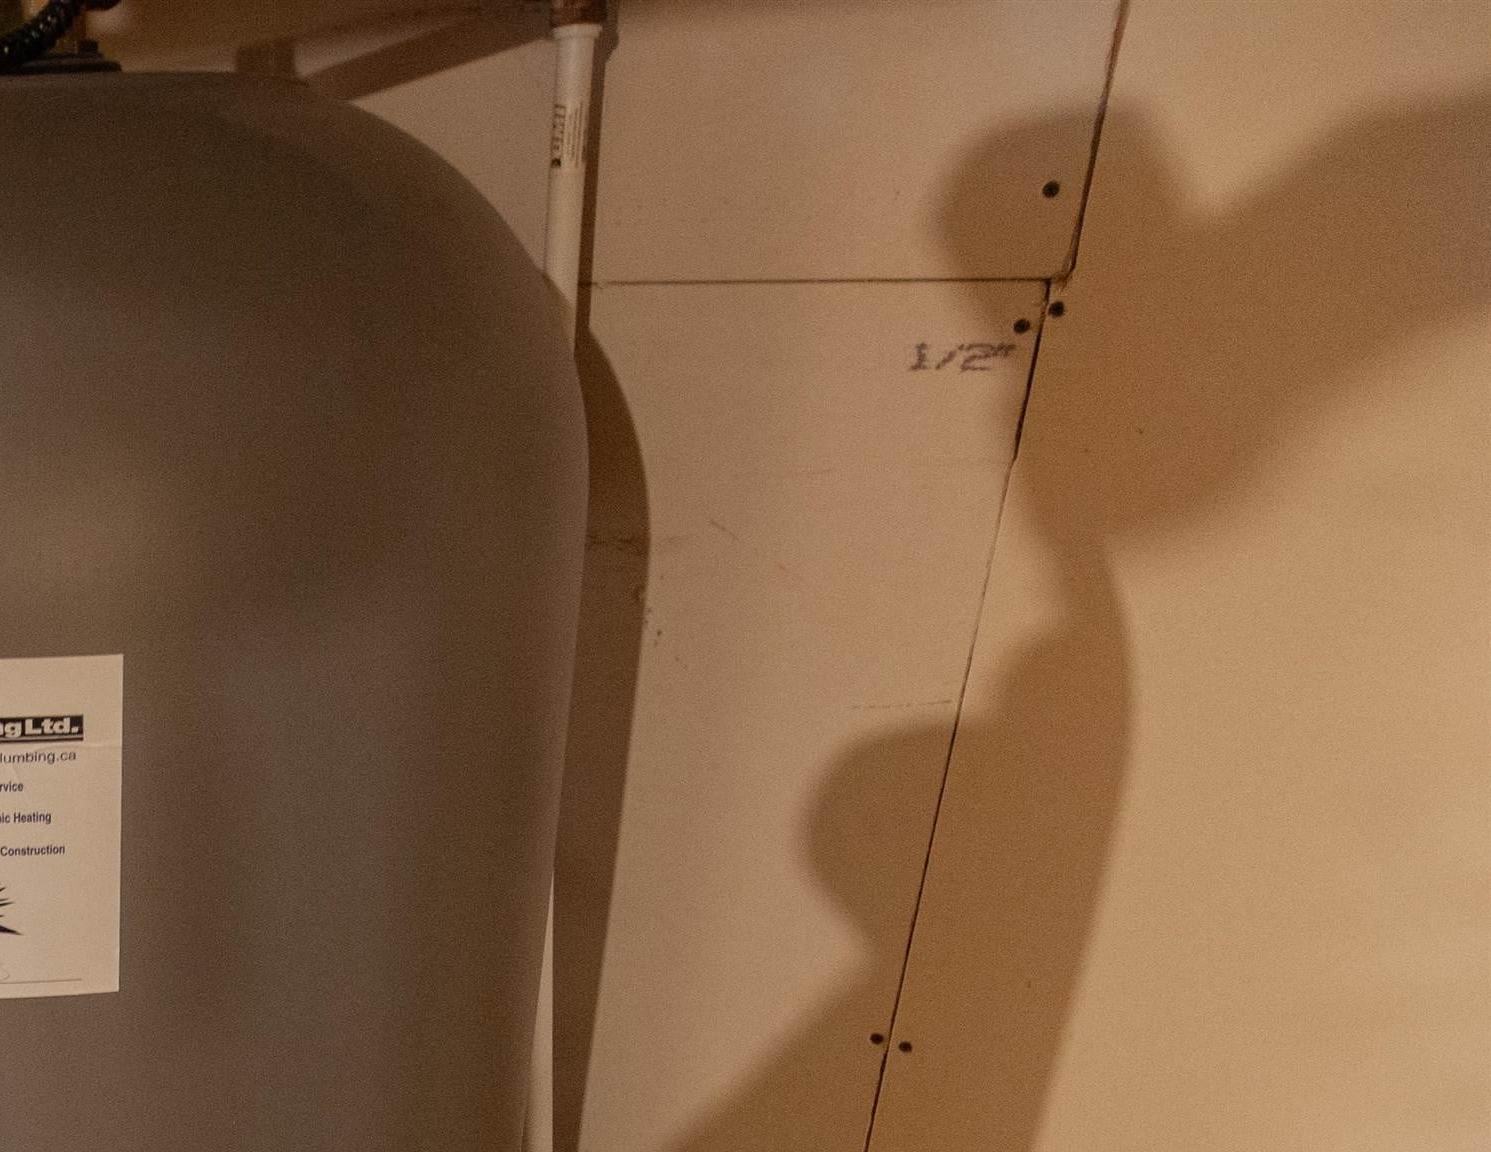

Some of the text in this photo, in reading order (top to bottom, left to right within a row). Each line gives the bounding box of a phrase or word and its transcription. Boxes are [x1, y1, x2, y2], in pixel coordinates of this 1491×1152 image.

[24, 717, 79, 736] Ltd.
[13, 811, 52, 825] Heating
[0, 843, 66, 857] Construction
